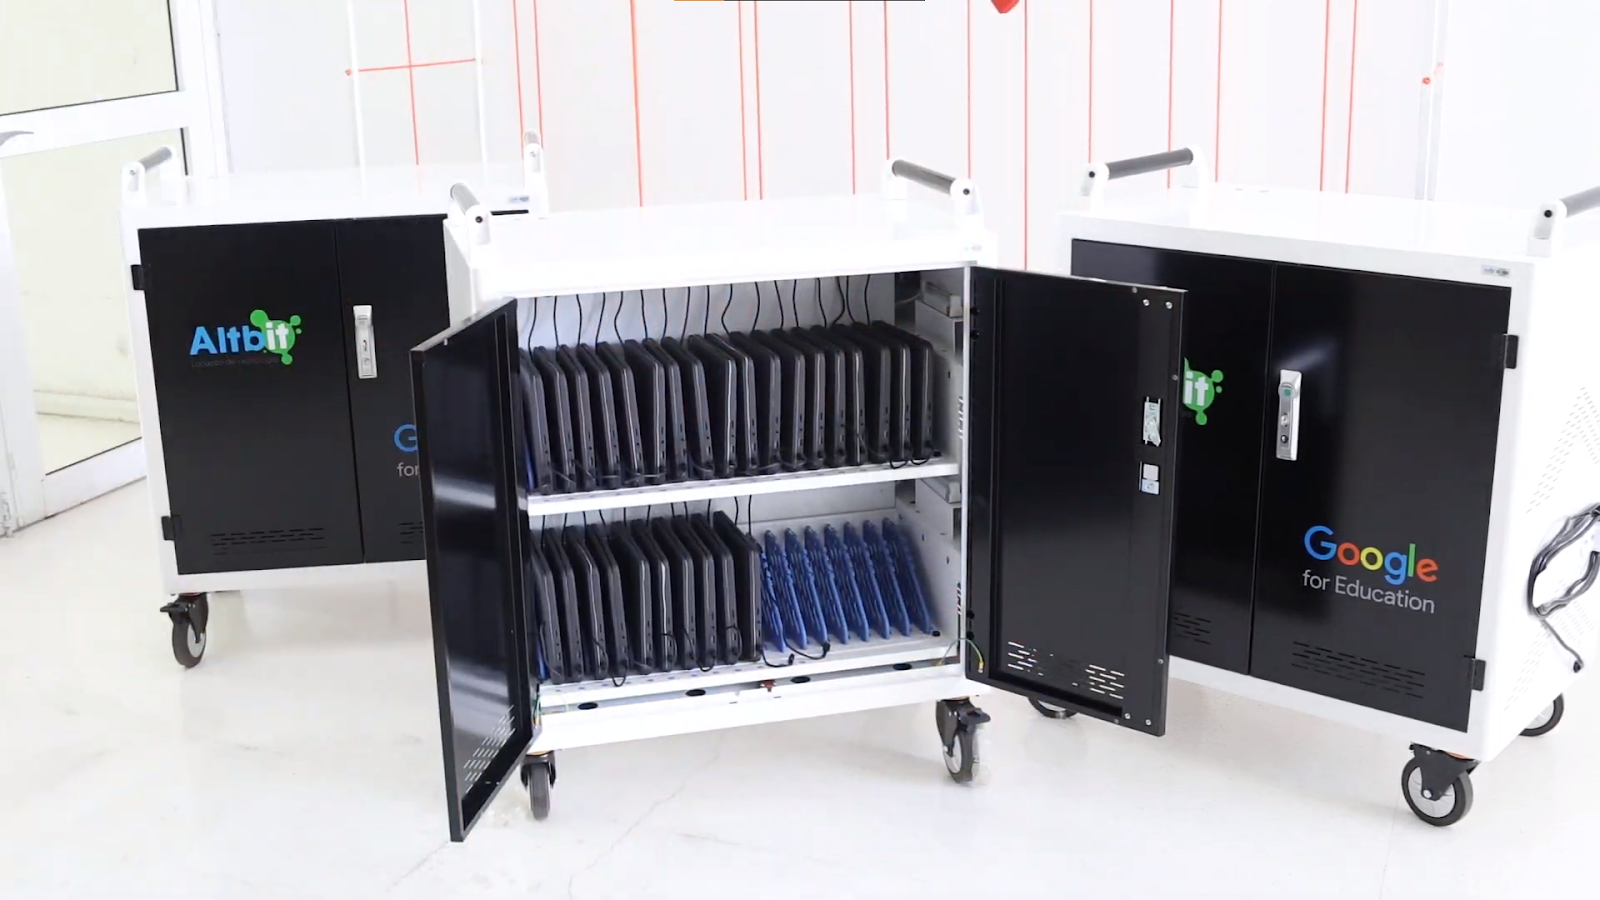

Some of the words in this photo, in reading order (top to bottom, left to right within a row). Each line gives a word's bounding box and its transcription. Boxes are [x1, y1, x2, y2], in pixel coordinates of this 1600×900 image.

[189, 321, 289, 355] Altbit
[1304, 525, 1439, 585] Google
[1302, 569, 1331, 591] for
[1335, 575, 1435, 614] Education
